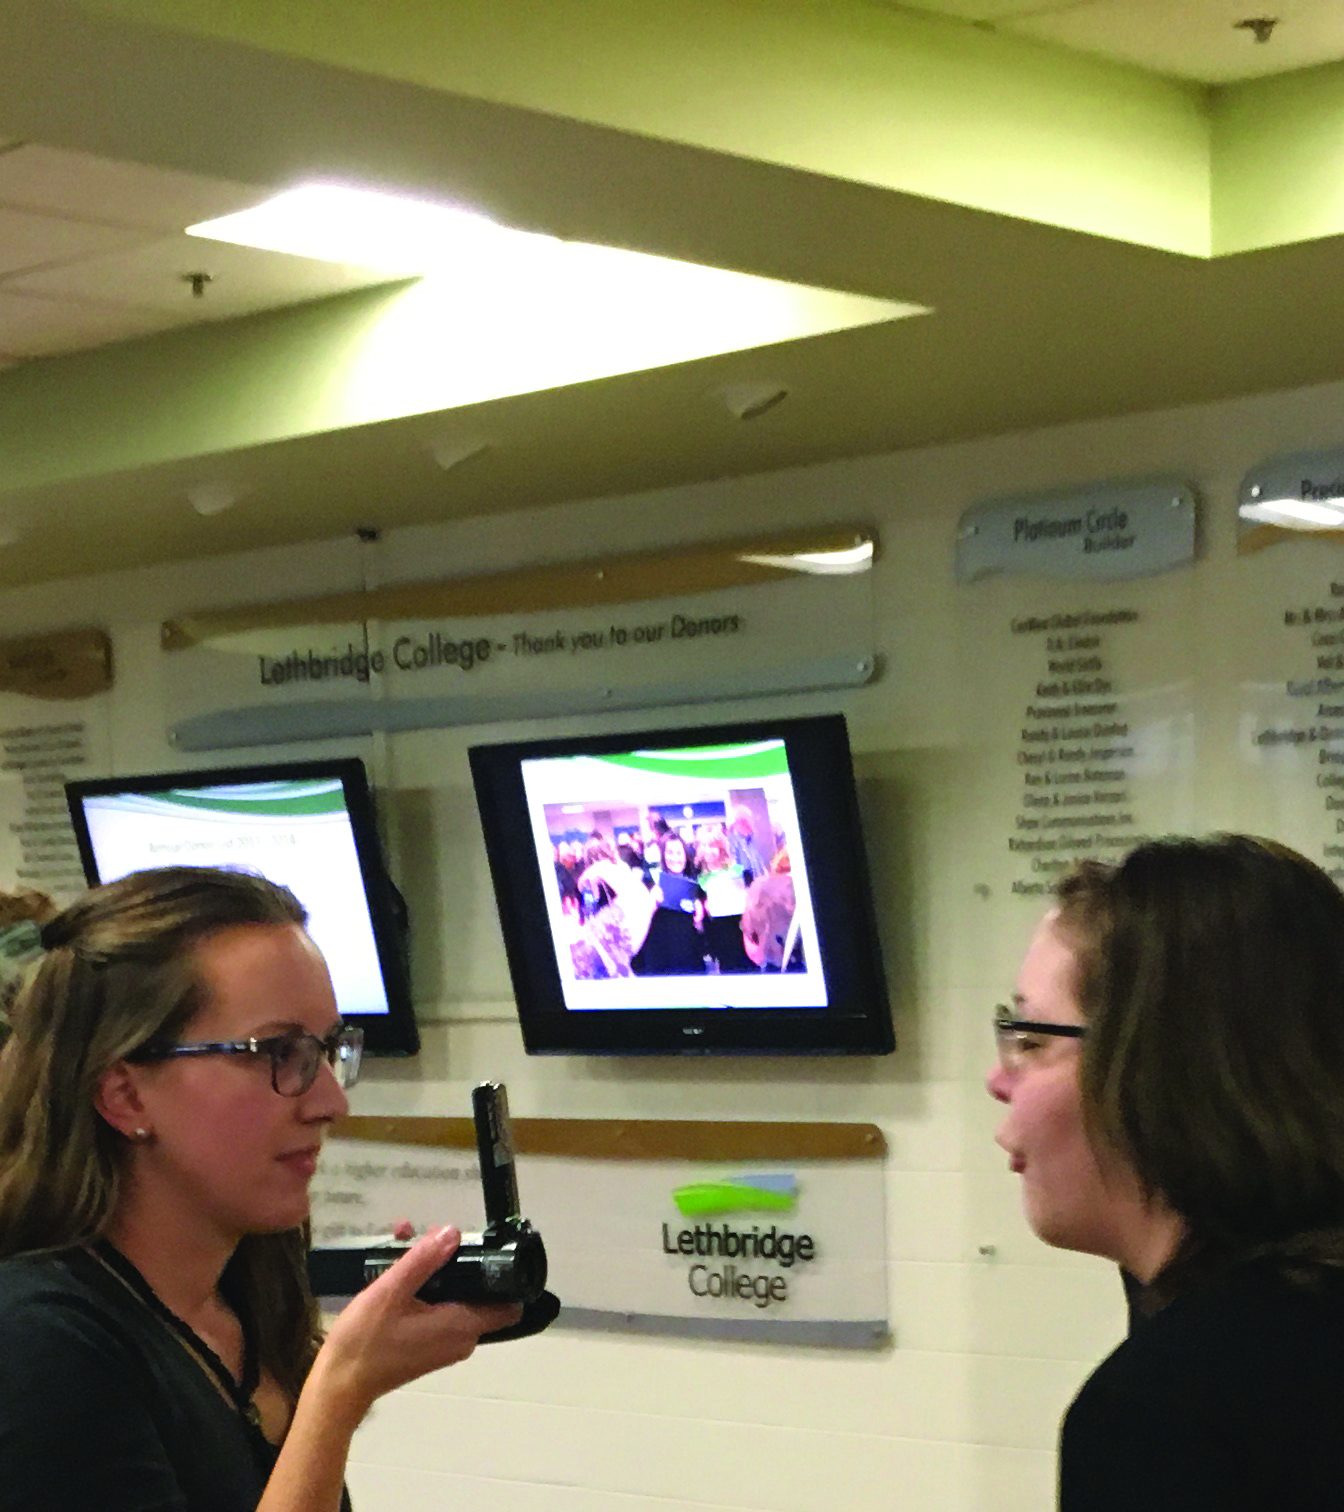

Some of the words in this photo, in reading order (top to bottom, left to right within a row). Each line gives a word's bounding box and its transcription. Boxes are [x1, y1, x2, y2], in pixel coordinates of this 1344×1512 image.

[1014, 516, 1083, 543] Platinum
[1086, 506, 1129, 534] Circle
[259, 643, 386, 685] Lethbridge
[393, 632, 492, 671] College
[512, 629, 565, 656] Thank
[570, 631, 604, 656] you
[609, 624, 628, 646] to
[632, 625, 665, 644] our
[670, 613, 741, 639] Donors
[1308, 726, 1317, 743] &
[1045, 770, 1052, 785] &
[662, 1222, 818, 1269] Lethbridge
[688, 1264, 788, 1308] College
